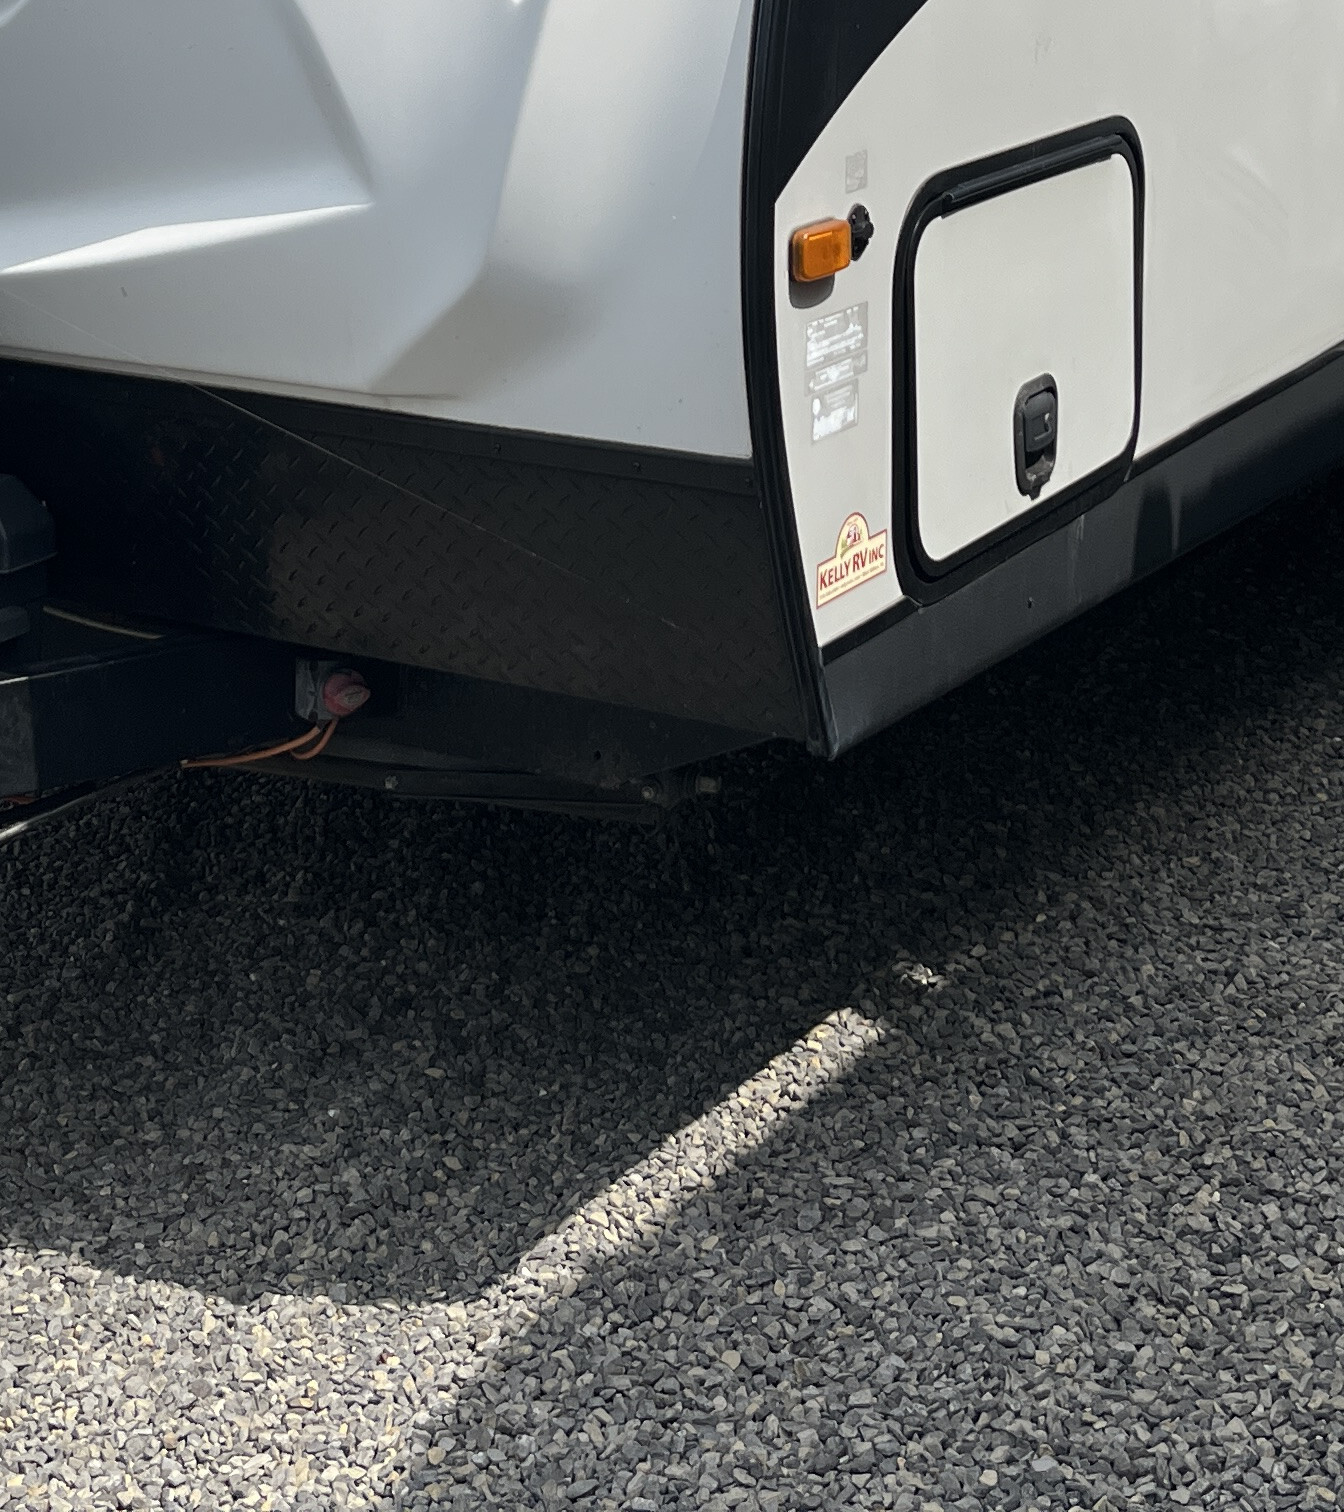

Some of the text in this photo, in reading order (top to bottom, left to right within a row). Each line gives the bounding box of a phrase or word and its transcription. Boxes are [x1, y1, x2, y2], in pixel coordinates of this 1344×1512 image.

[820, 559, 851, 590] KELLY
[853, 549, 868, 572] RV
[869, 544, 885, 564] INC
